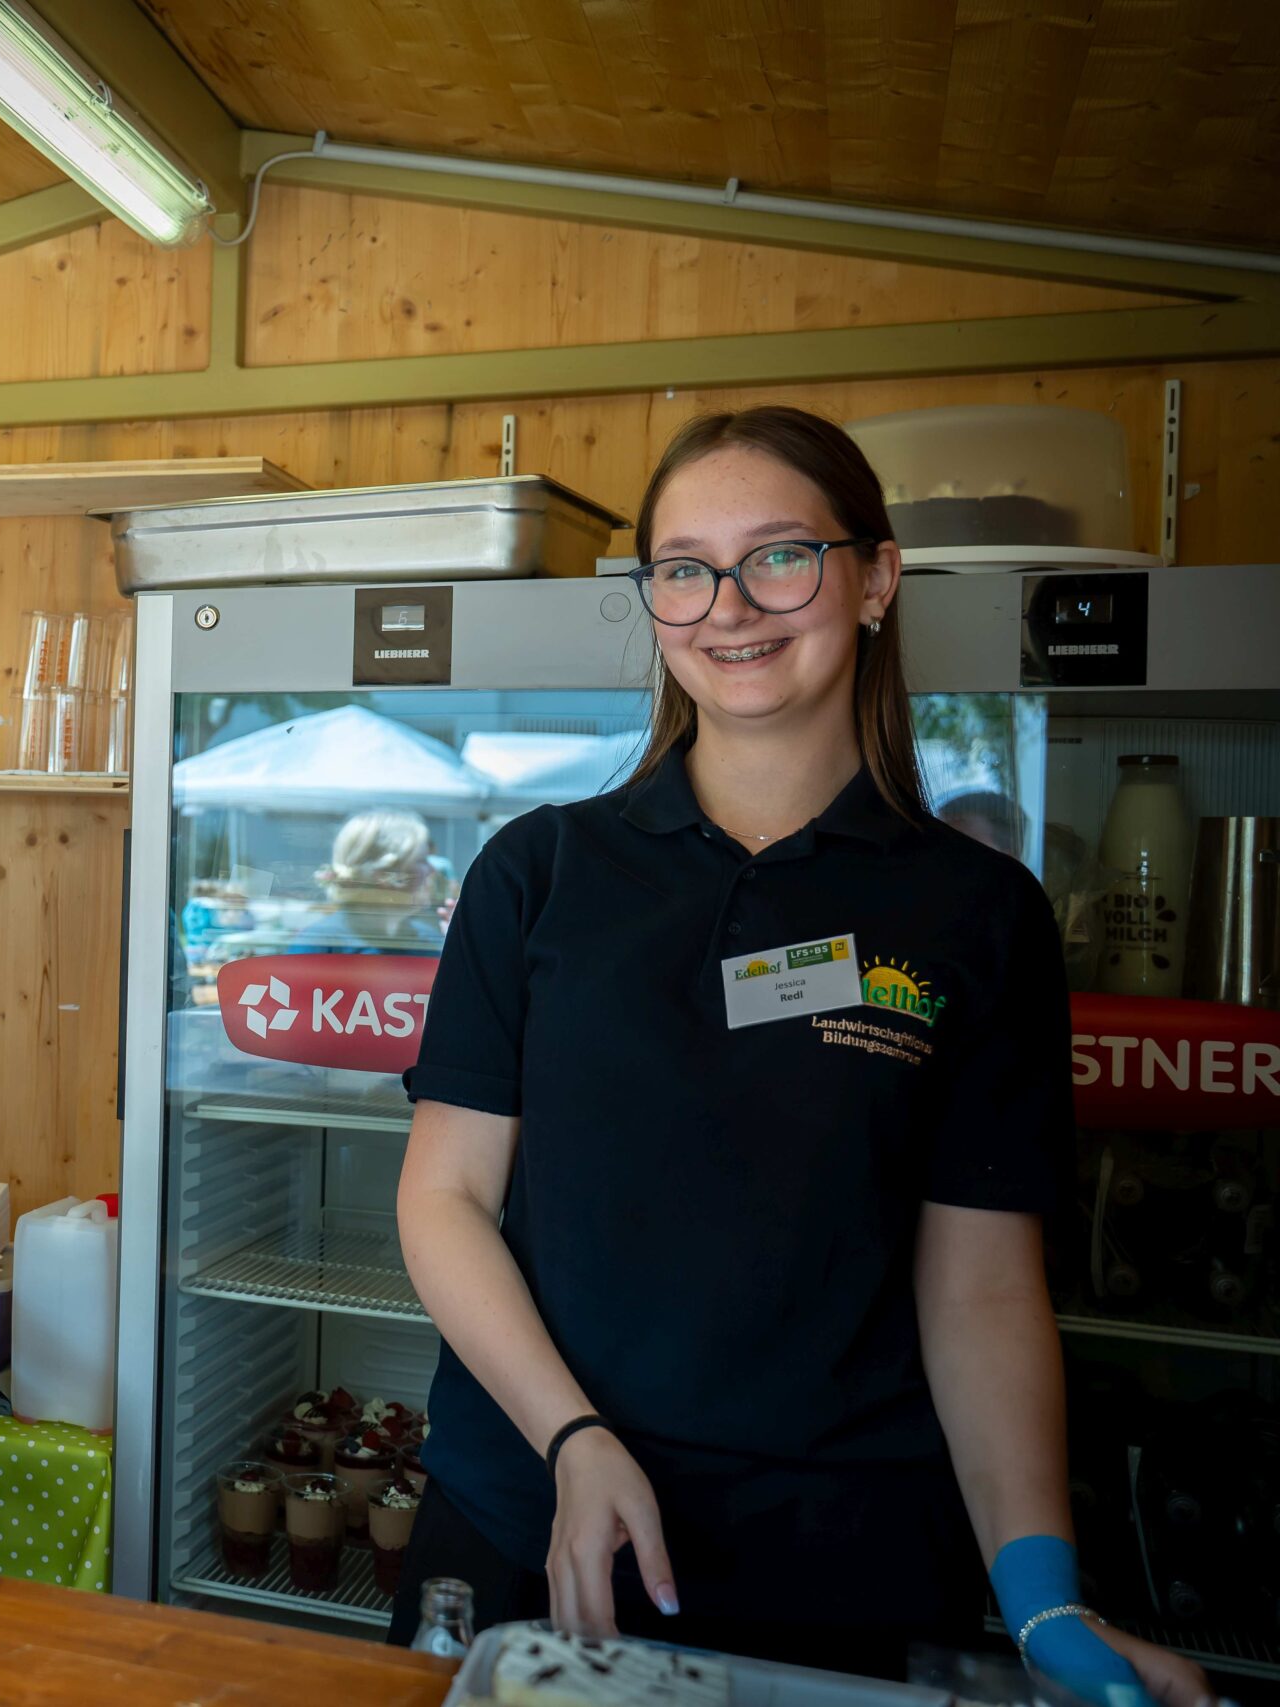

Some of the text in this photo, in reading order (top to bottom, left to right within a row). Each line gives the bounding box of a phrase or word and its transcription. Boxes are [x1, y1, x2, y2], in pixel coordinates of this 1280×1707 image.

[1078, 601, 1091, 617] 4
[398, 611, 409, 625] 6
[374, 649, 430, 659] LIEBHERR
[1047, 643, 1120, 656] LIEBHERR
[1114, 894, 1150, 908] BIO
[1104, 910, 1151, 925] VOLL
[1105, 927, 1168, 942] MILCH
[790, 944, 829, 959] LFS+BS
[734, 961, 782, 981] Edelhof
[774, 979, 806, 991] Jessica
[780, 990, 803, 1002] Redl
